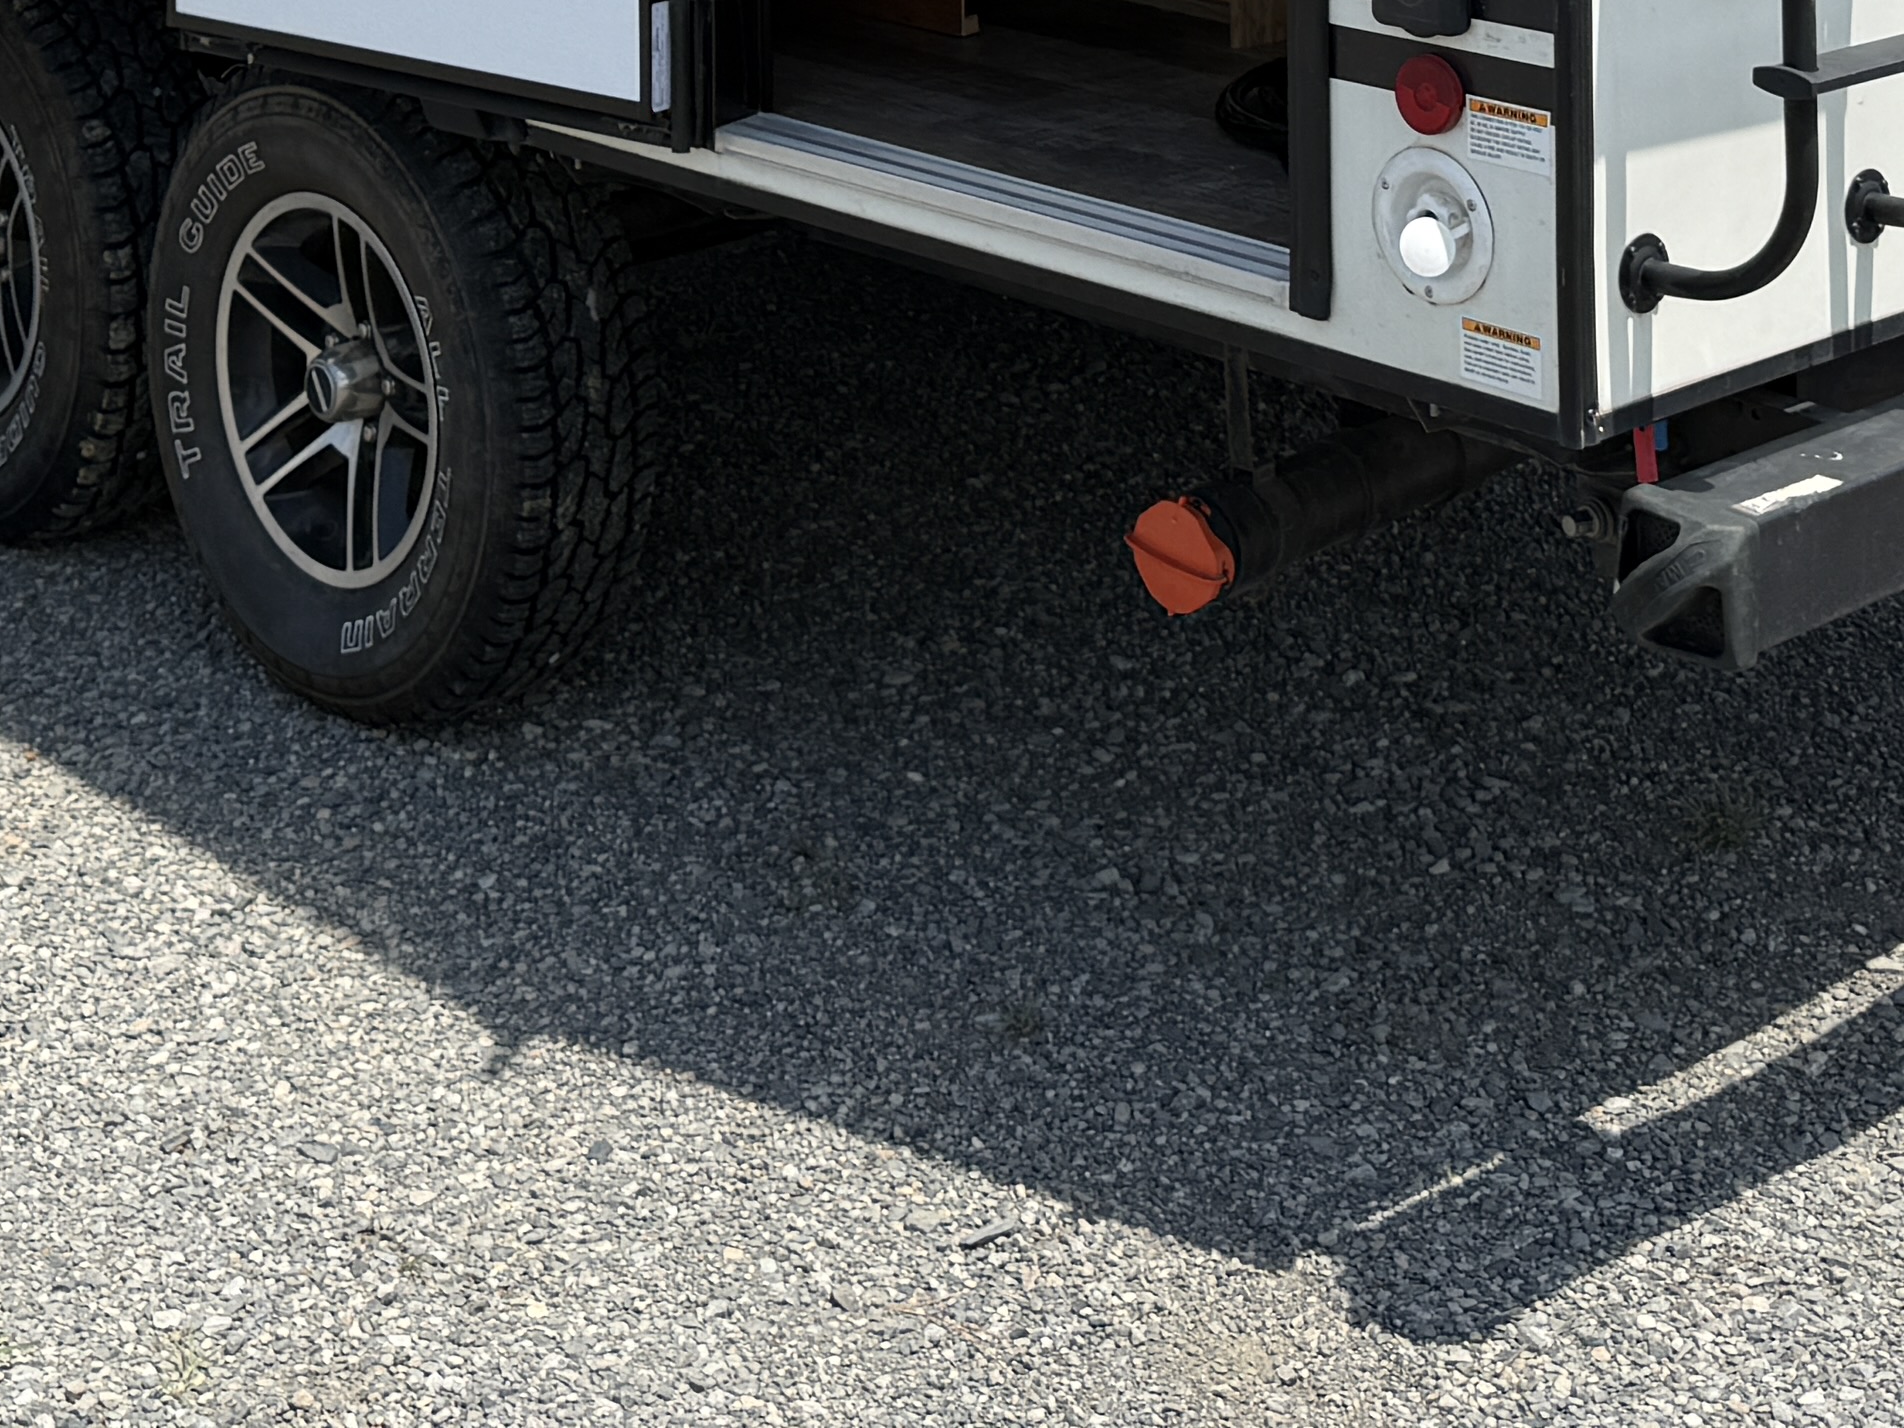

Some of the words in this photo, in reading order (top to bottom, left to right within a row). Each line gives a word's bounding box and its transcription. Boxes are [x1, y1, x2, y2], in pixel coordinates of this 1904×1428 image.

[1485, 104, 1538, 123] WARNING
[179, 140, 266, 255] GUIDE
[163, 284, 201, 480] TRAIL
[1482, 323, 1532, 346] WARNING
[340, 467, 452, 654] TERRAIN
